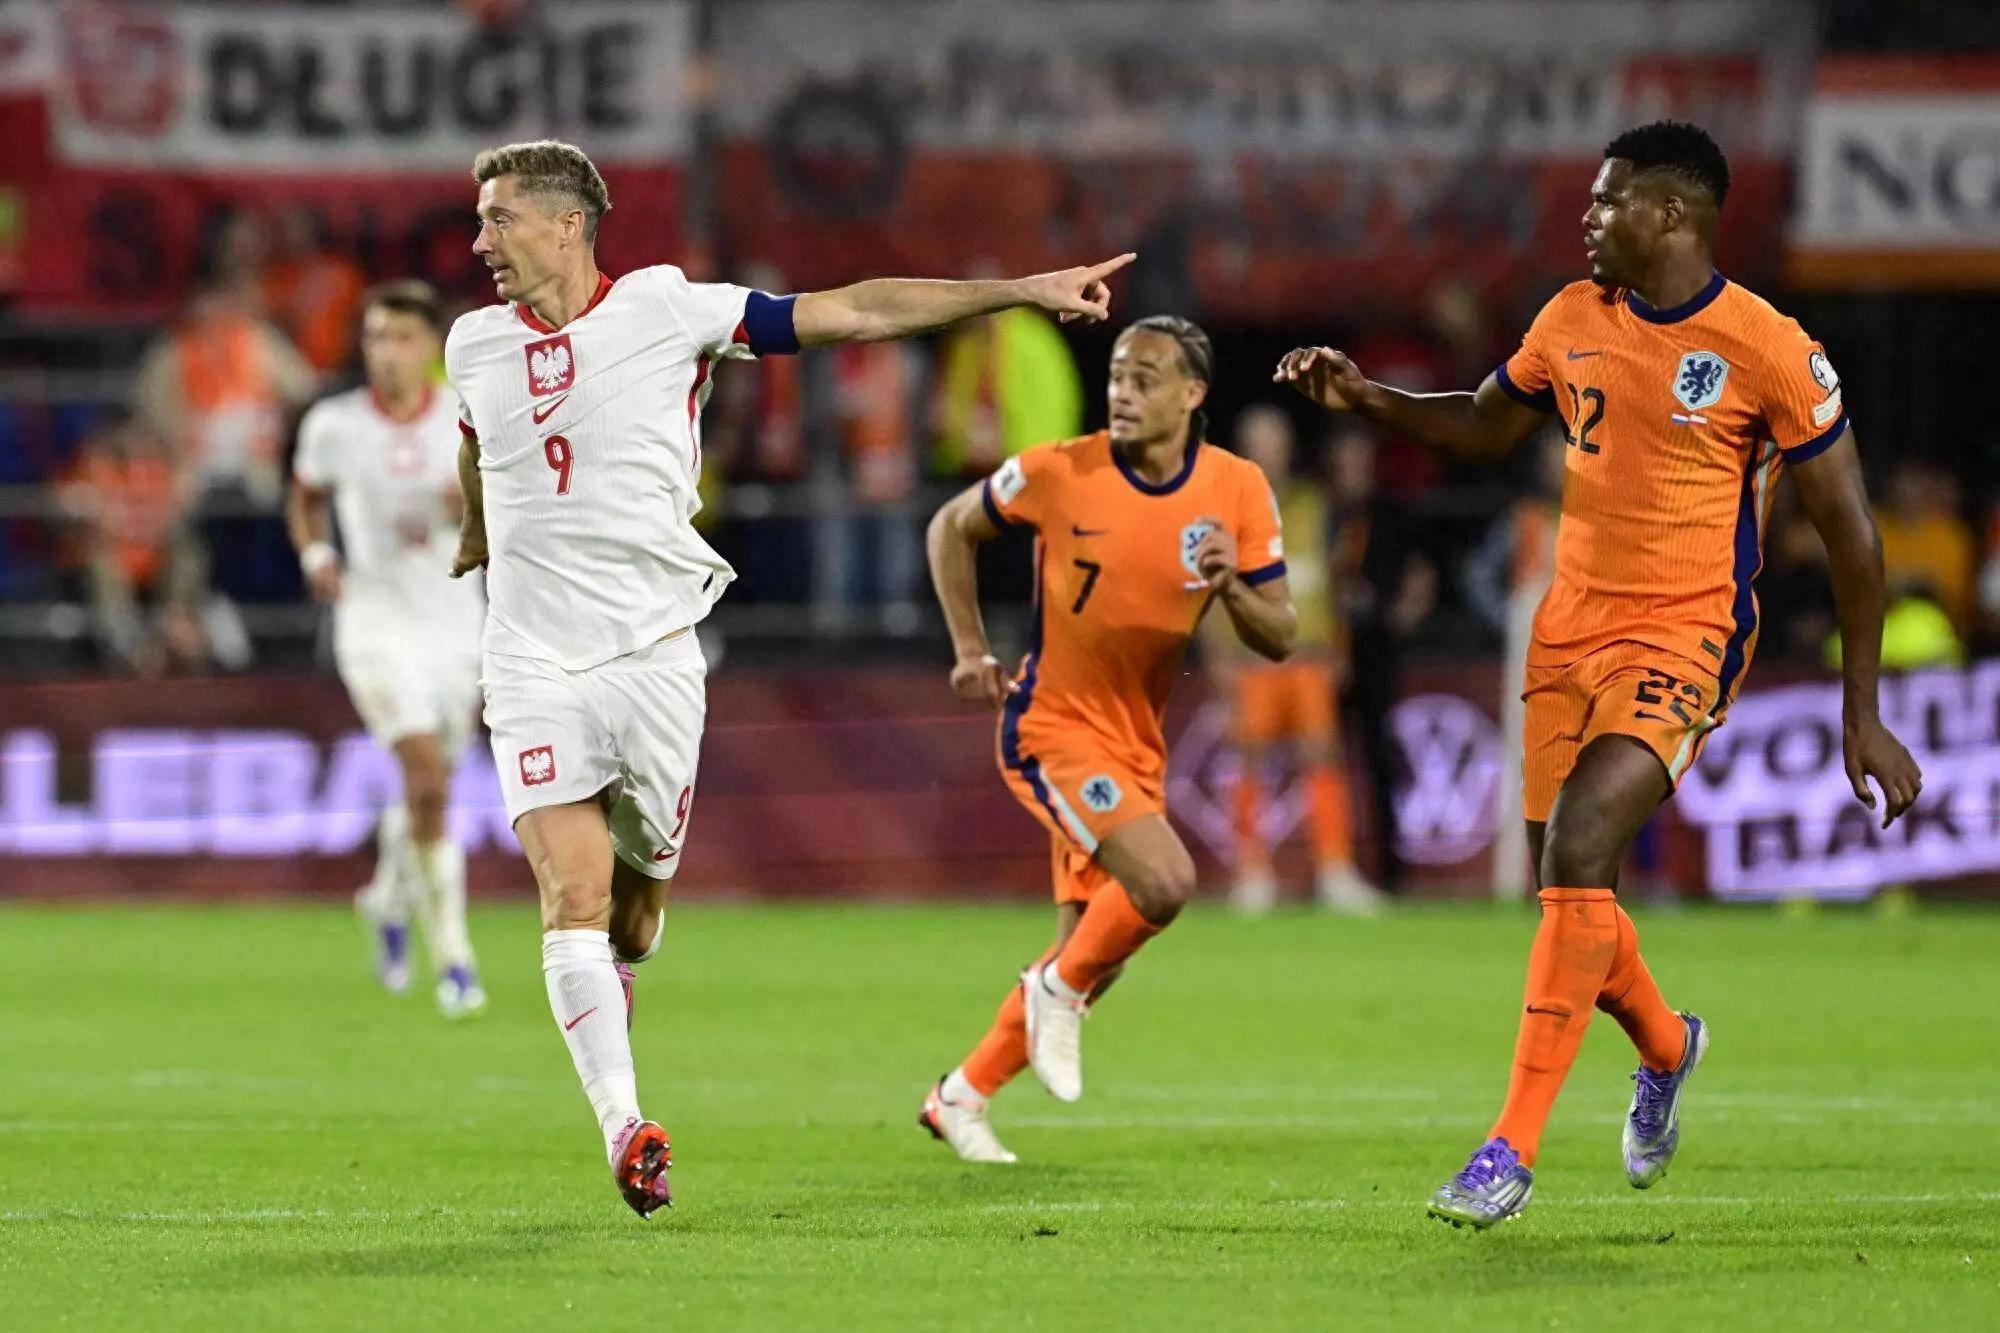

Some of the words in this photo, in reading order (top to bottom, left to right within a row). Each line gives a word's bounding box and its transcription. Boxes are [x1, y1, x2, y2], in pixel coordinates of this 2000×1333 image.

[544, 434, 574, 495] 9
[1072, 558, 1100, 614] 7
[669, 784, 691, 840] 9
